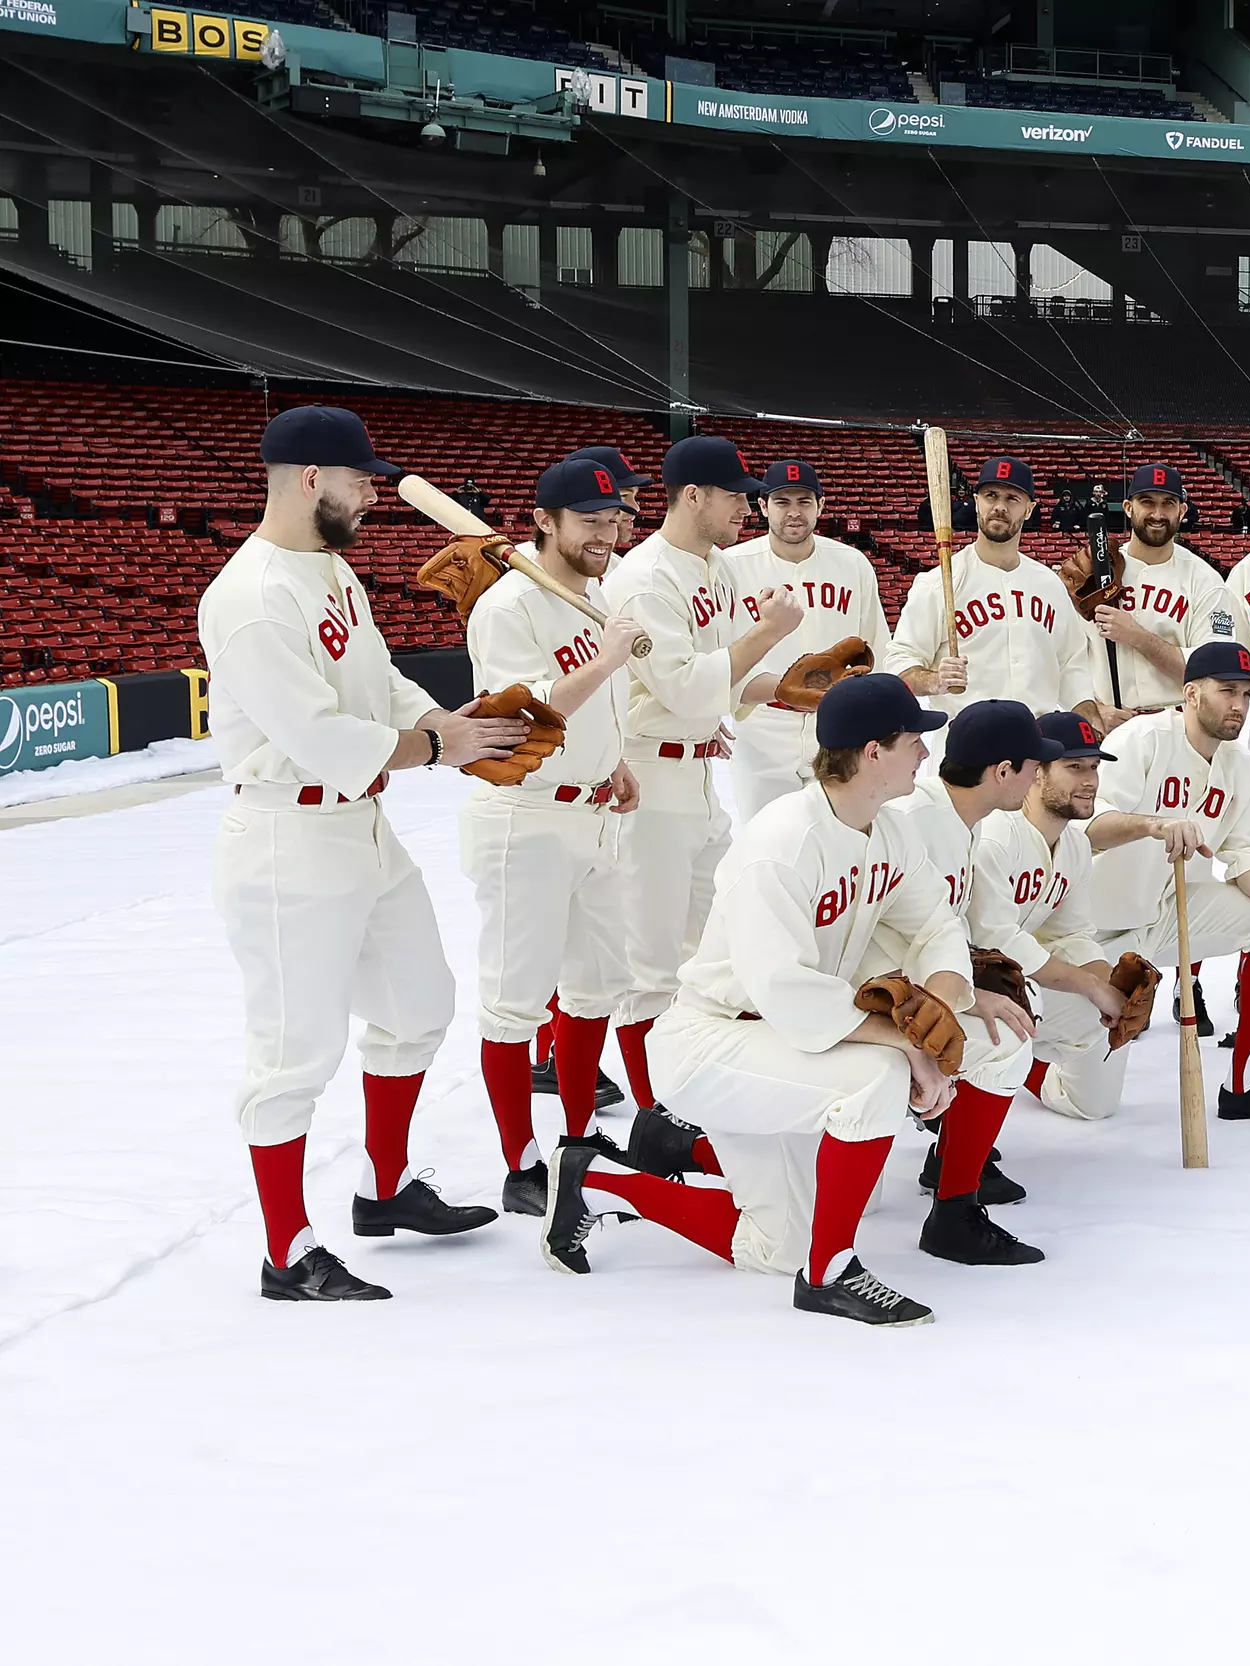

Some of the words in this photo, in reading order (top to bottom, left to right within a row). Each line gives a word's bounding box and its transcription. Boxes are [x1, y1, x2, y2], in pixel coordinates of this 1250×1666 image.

[7, 0, 56, 13] FEDERAL
[18, 11, 57, 25] UNION
[158, 20, 263, 52] BOS
[698, 100, 718, 117] NEW
[718, 103, 778, 123] AMSTERDAM
[779, 108, 809, 125] VODKA
[897, 112, 944, 129] pepsi
[1021, 126, 1085, 143] verizon
[1186, 136, 1244, 150] FANDUEL
[304, 189, 316, 202] 21
[717, 222, 732, 236] 22
[1125, 237, 1139, 249] 23
[785, 463, 801, 481] B
[995, 461, 1013, 479] B
[1152, 468, 1167, 486] B
[594, 469, 615, 494] B
[742, 582, 853, 623] BTON
[1122, 584, 1189, 623] STON
[954, 590, 1055, 639] BOSTON
[26, 691, 83, 742] pepsi
[1078, 721, 1097, 745] B
[34, 743, 53, 757] ZERO
[53, 740, 77, 753] SUGAR
